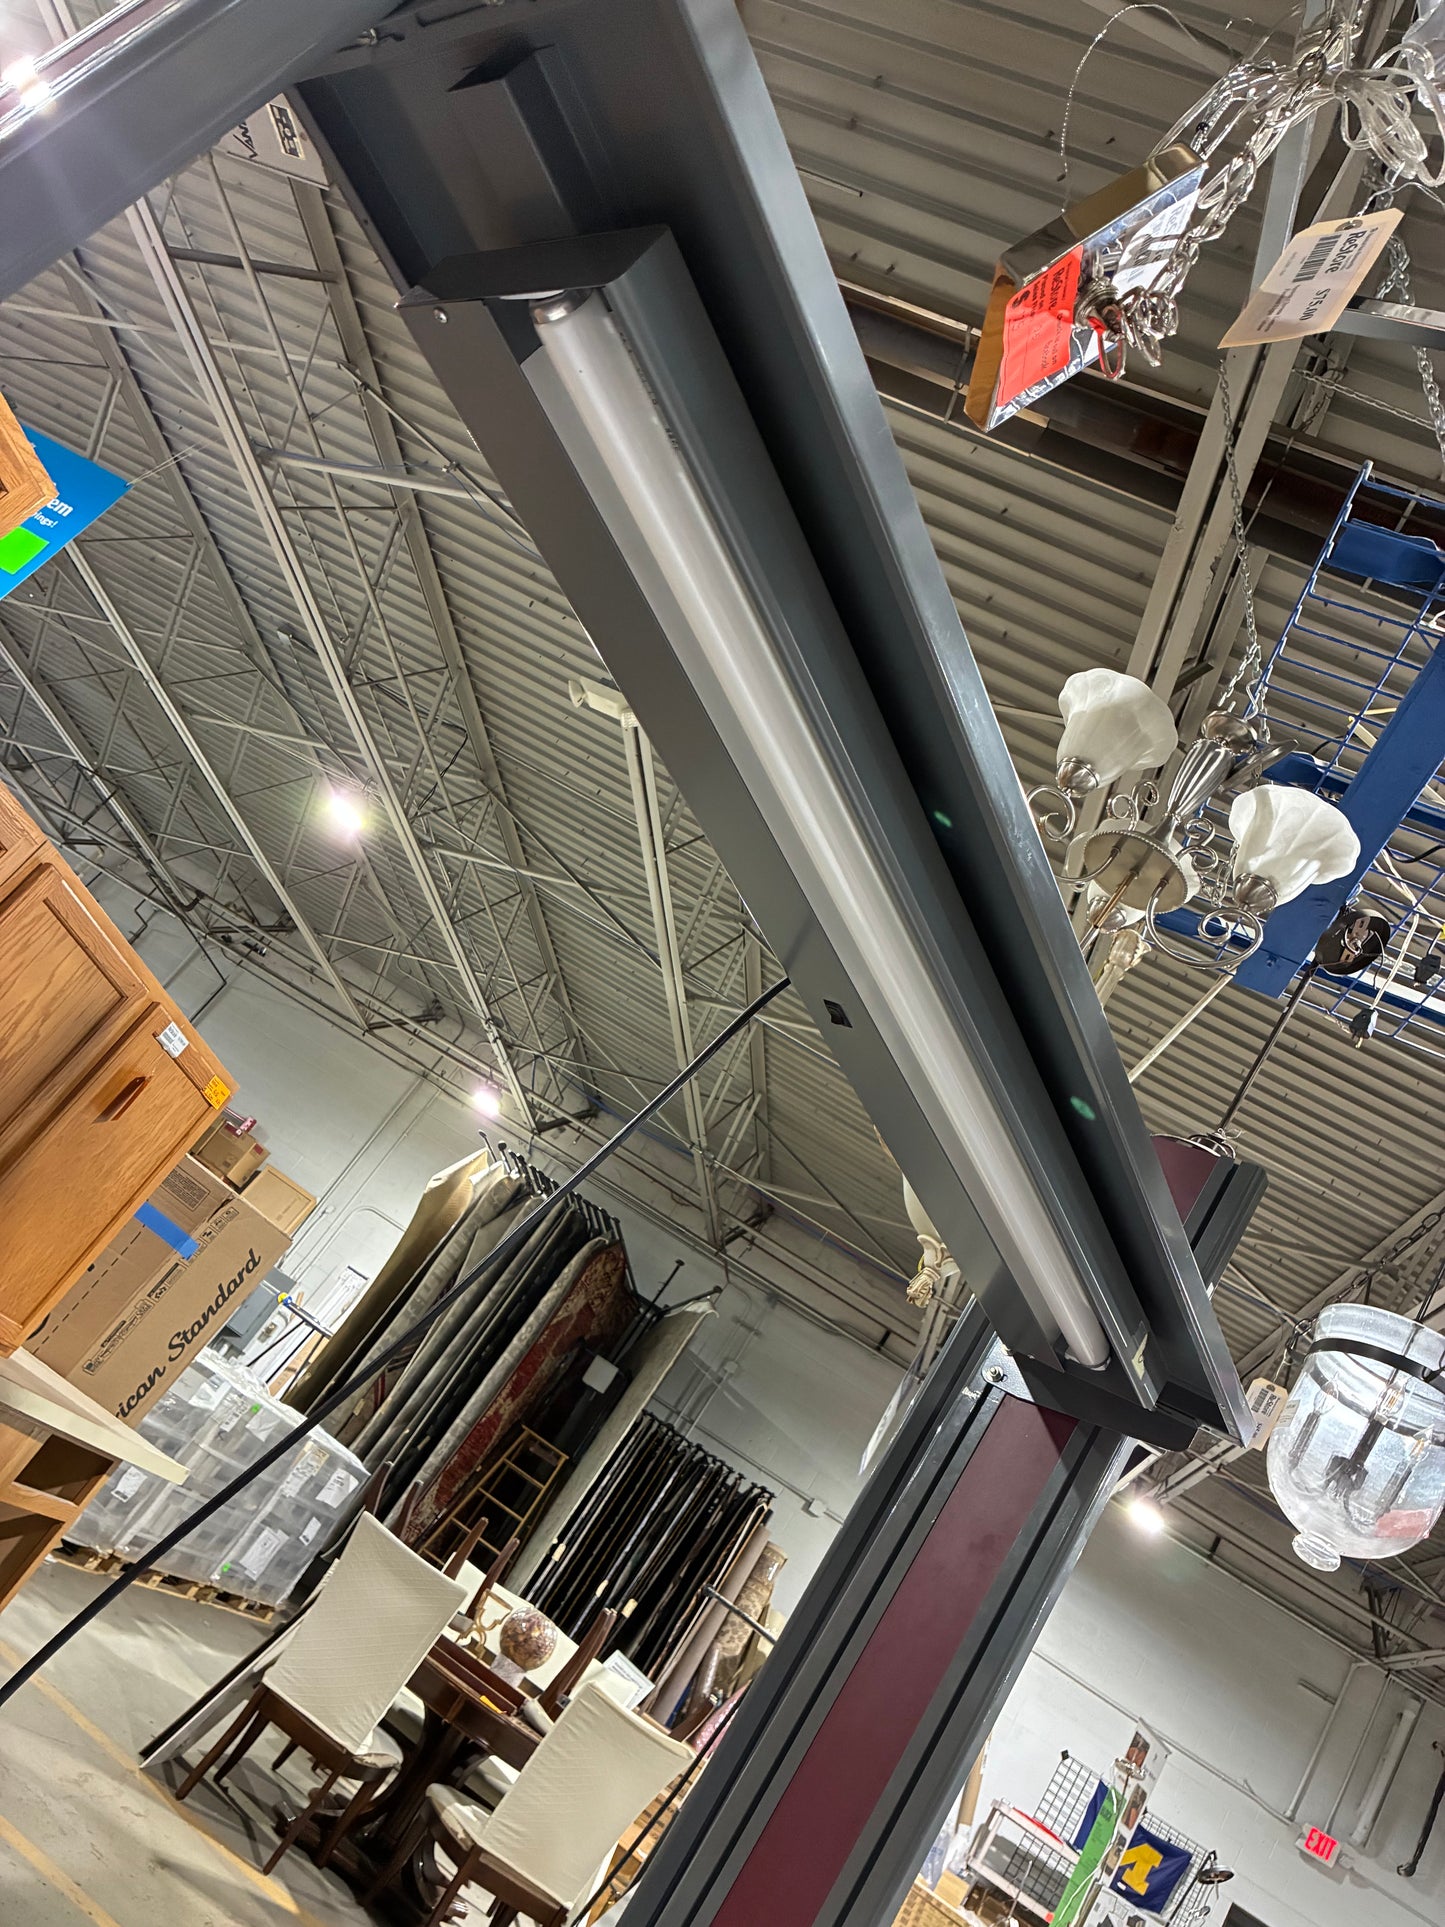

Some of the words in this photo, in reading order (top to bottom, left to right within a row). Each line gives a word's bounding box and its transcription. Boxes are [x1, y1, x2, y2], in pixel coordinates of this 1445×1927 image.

[1324, 230, 1368, 274] ReStore
[1048, 267, 1065, 311] ReStore
[1299, 288, 1331, 321] $75.00
[34, 511, 59, 528] ings!
[168, 1247, 262, 1363] Standard
[1304, 1827, 1338, 1861] EXIT
